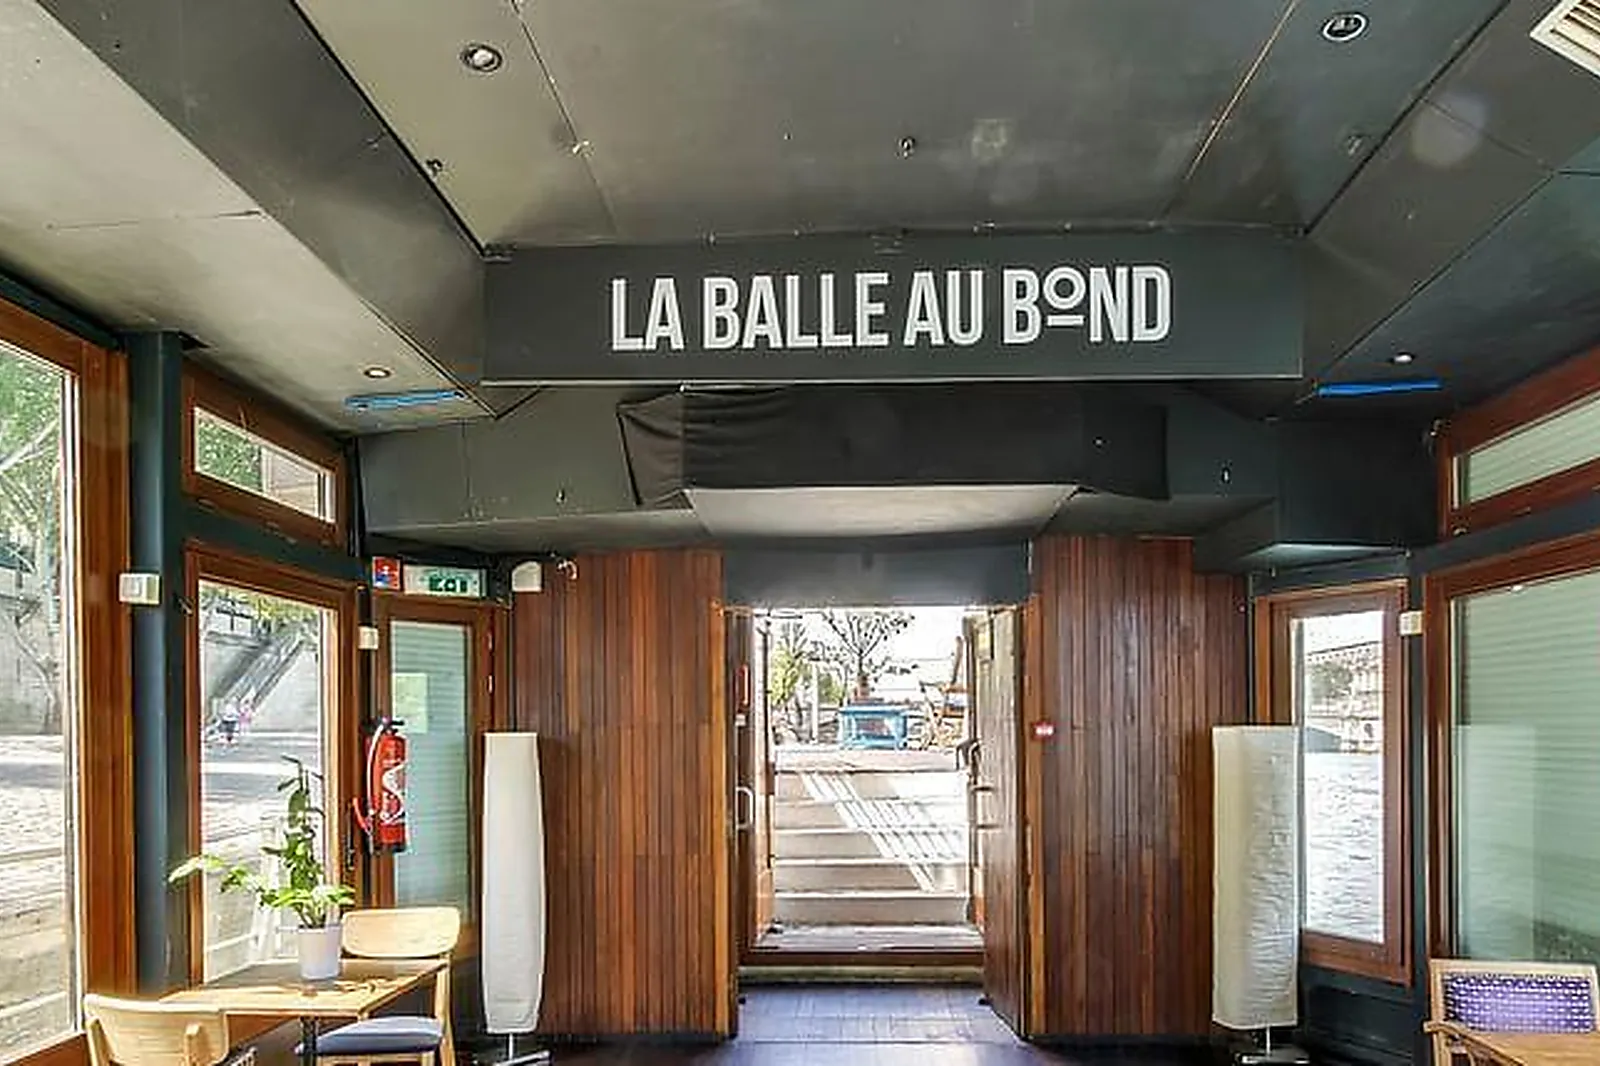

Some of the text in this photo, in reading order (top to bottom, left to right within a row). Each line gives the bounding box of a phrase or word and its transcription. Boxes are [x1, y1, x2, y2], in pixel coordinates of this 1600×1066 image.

[611, 277, 684, 351] LA
[702, 271, 889, 350] BALLE
[903, 269, 984, 346] AU
